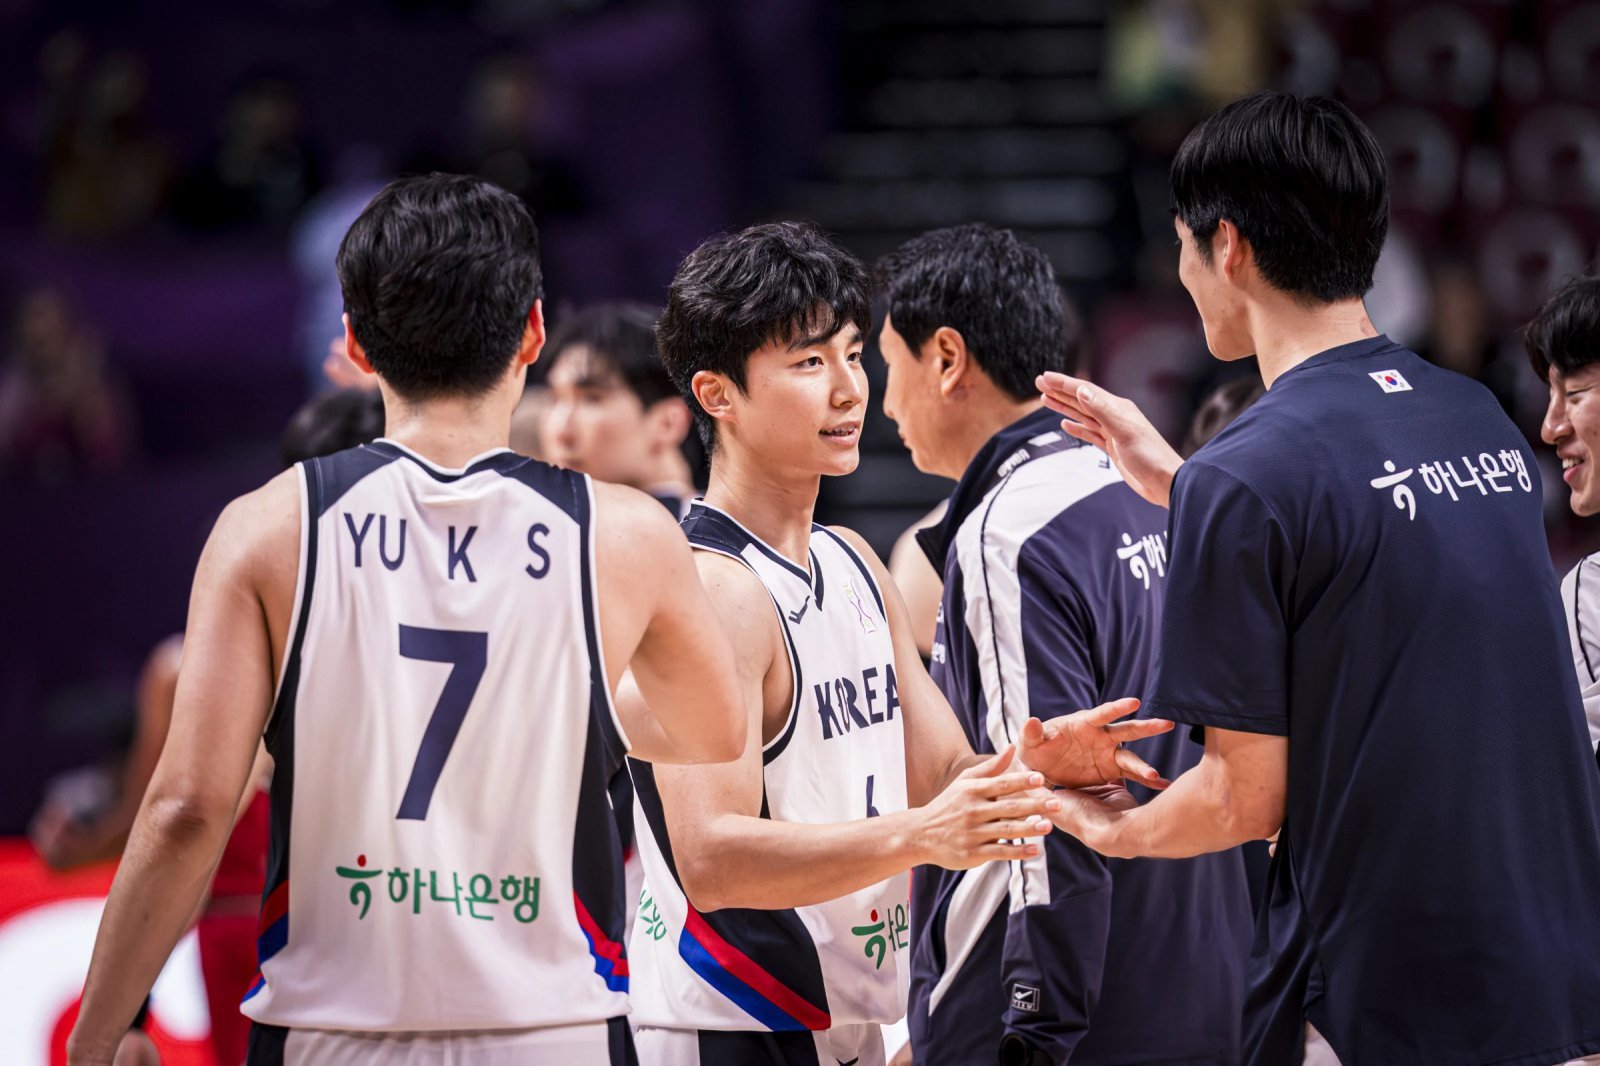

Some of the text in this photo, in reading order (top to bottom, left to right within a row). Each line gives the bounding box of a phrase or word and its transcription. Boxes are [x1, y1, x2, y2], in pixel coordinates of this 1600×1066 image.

[1417, 449, 1533, 502] 하나은행
[395, 622, 489, 822] 7
[813, 663, 901, 741] KOREA
[387, 867, 541, 924] 하나은행
